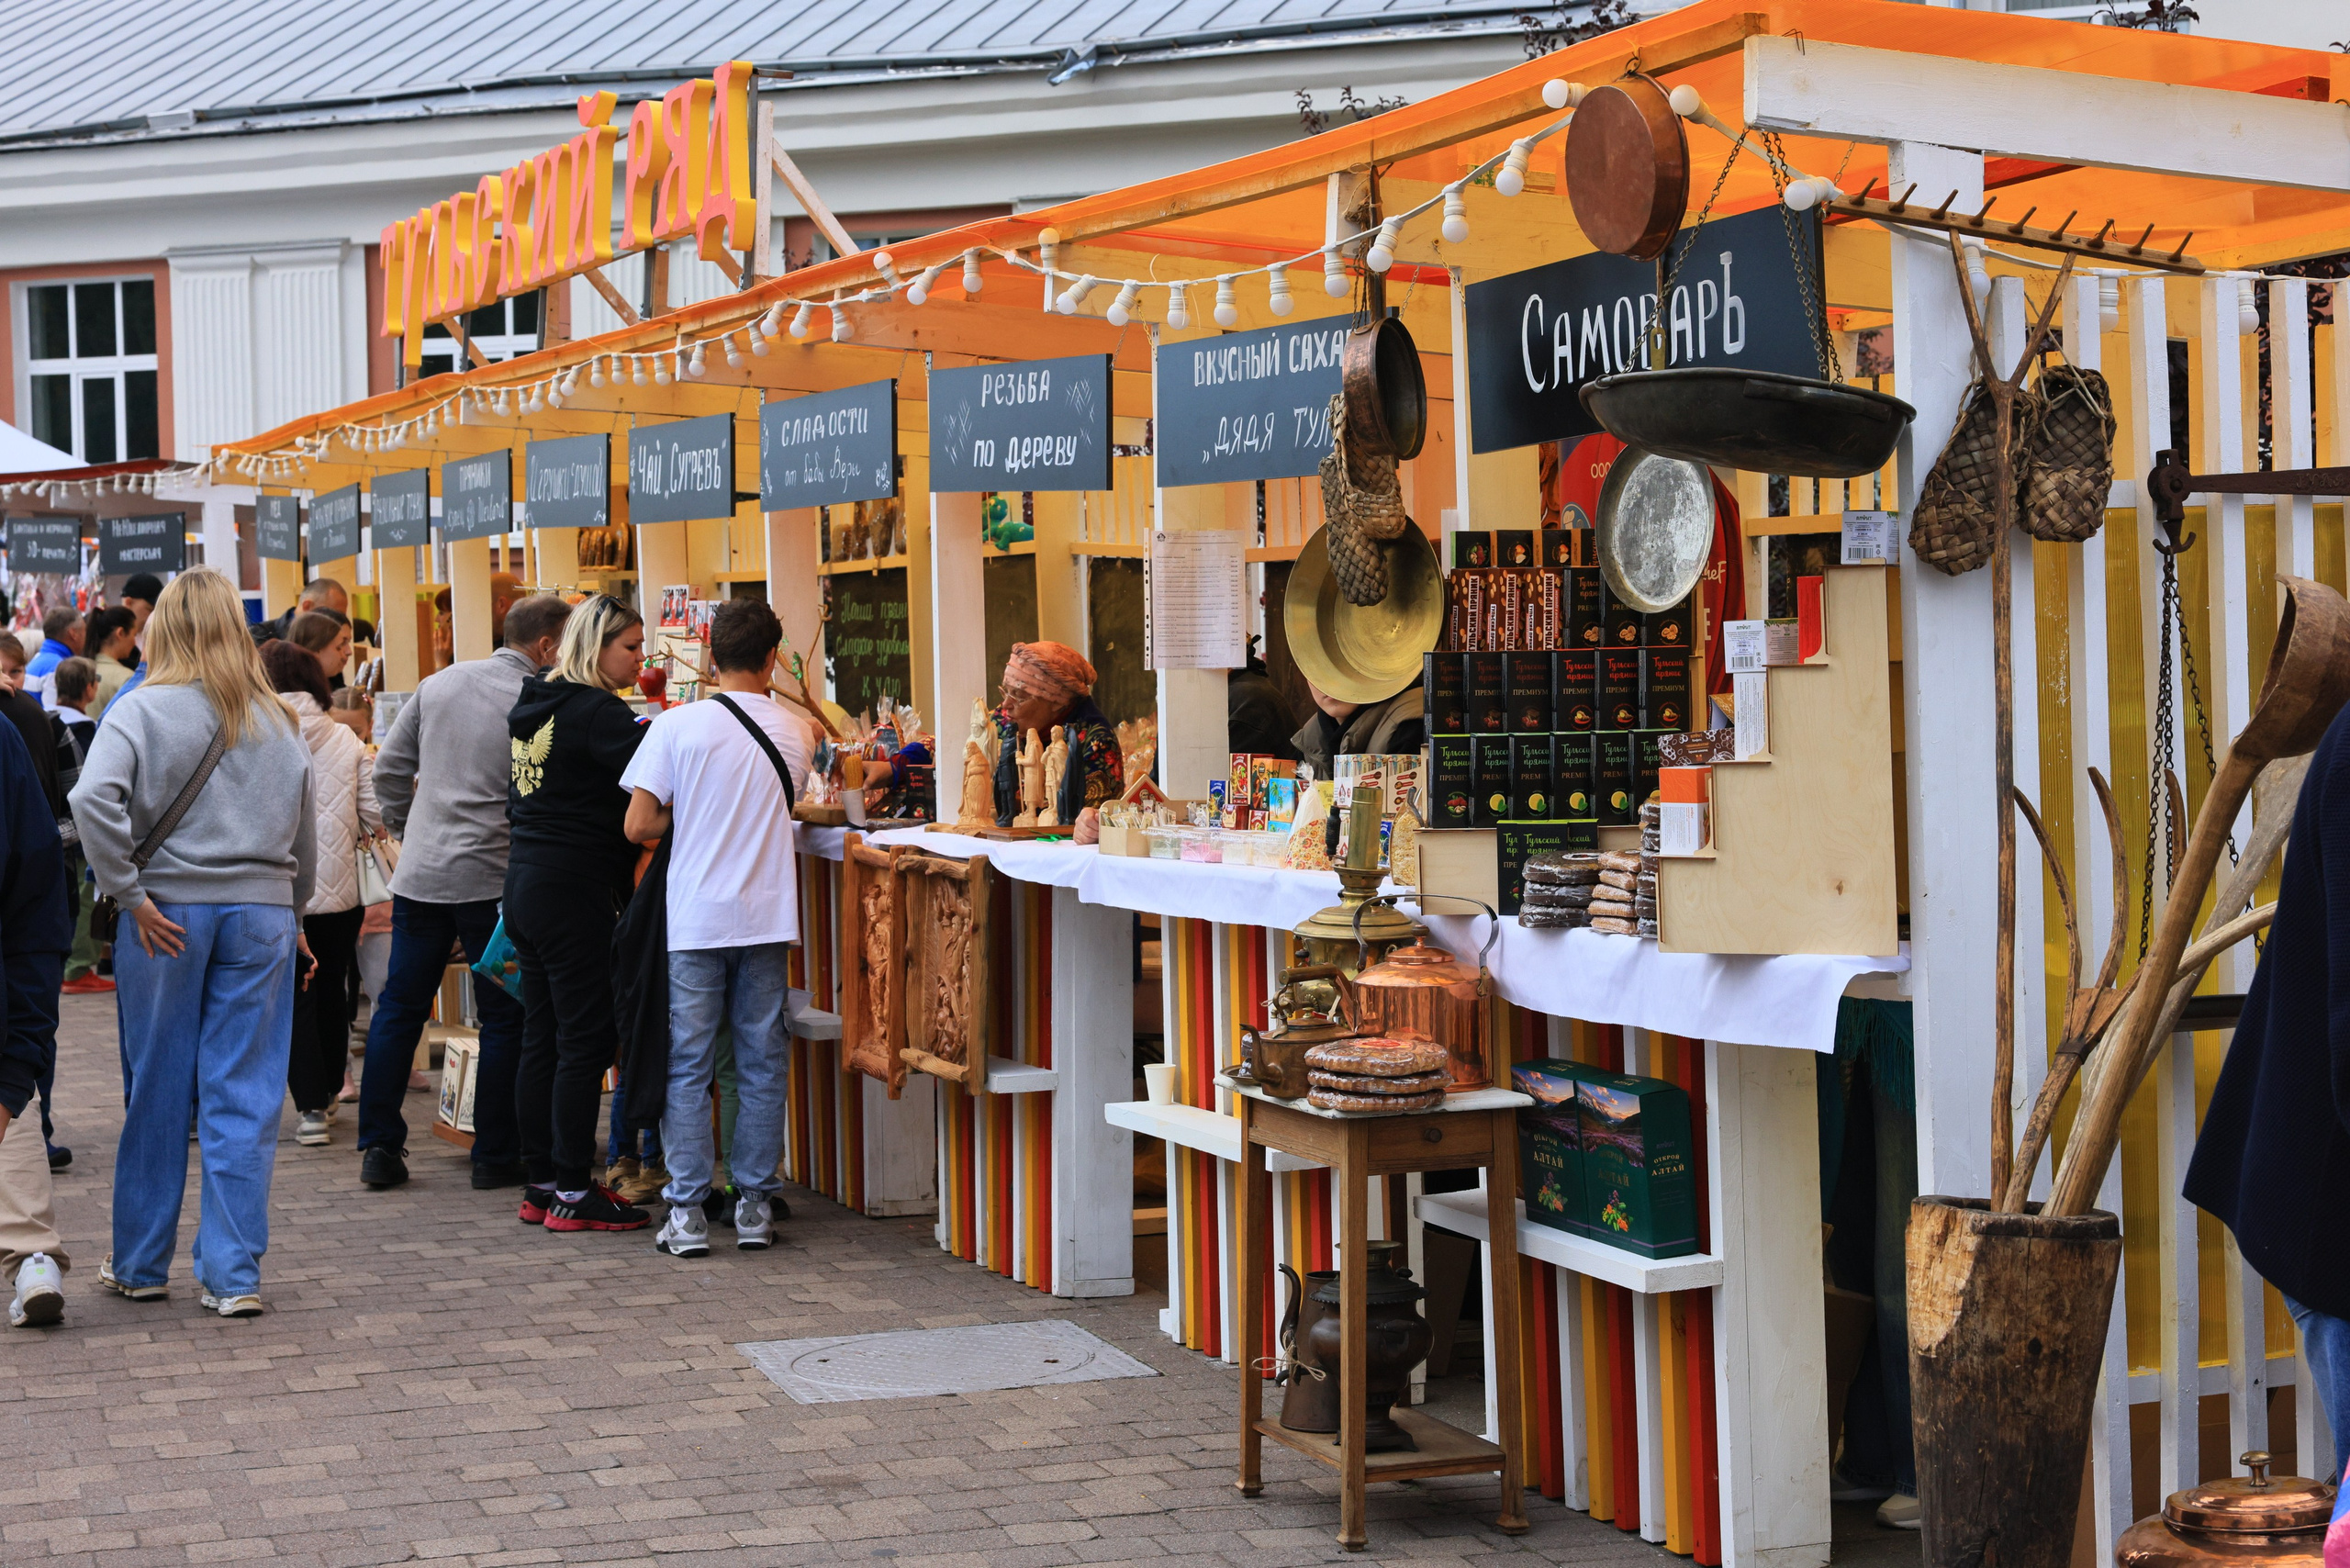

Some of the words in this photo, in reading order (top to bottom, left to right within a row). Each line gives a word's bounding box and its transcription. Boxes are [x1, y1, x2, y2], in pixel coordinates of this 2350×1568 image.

[380, 90, 619, 367] ТУЛЬСКИЙ
[619, 60, 756, 263] РЯД
[1194, 332, 1280, 387] ВКУСНЫЙ
[1289, 329, 1356, 373] САХА
[1293, 407, 1335, 448] ТУЛ
[785, 470, 797, 487] от
[803, 451, 824, 484] бабы
[830, 445, 861, 494] Веры
[1470, 577, 1479, 610] ПРЯНИК
[1507, 576, 1516, 608] ПРЯНИК
[1545, 576, 1553, 608] ПРЯНИК
[1652, 656, 1684, 670] Тульский
[1656, 670, 1682, 680] пряник
[1506, 846, 1518, 857] пр
[1524, 834, 1561, 846] Тульский
[1534, 1151, 1563, 1169] АЛТАЙ
[1651, 1163, 1684, 1176] АЛТАЙ
[1653, 1154, 1680, 1164] ОТКРОЙ
